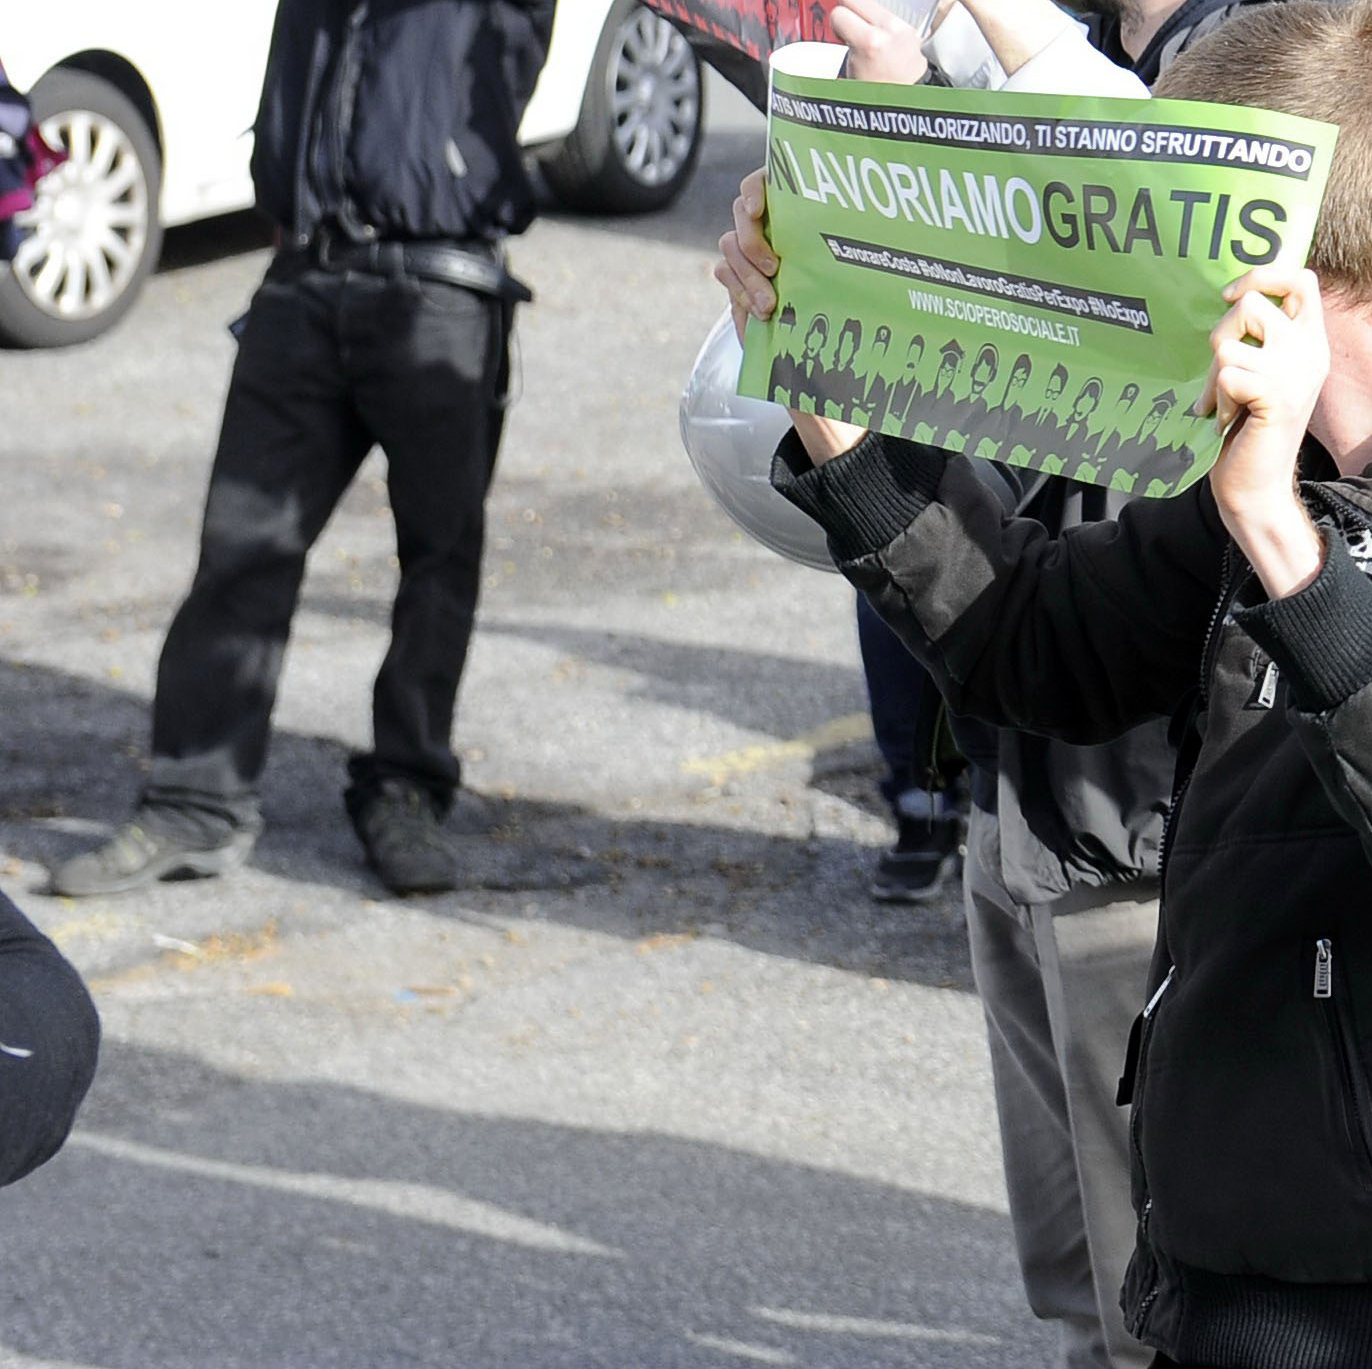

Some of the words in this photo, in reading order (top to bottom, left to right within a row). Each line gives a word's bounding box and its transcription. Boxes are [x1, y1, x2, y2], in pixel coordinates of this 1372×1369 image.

[791, 99, 820, 122] NON
[820, 104, 835, 125] TI
[838, 107, 868, 130] STAI
[870, 111, 1031, 150] AUTOVALORIZZANDO,
[1034, 125, 1052, 147] TI
[1055, 126, 1137, 153] STANNO
[1141, 131, 1312, 173] SFRUTTANDO
[827, 238, 921, 275] #LavorareCosta
[919, 259, 1089, 315] #IoNonLavoroGratisPerExpo
[1089, 295, 1149, 329] #NoExpo
[907, 289, 1081, 347] WWW.SCIOPEROSOCIALE.IT
